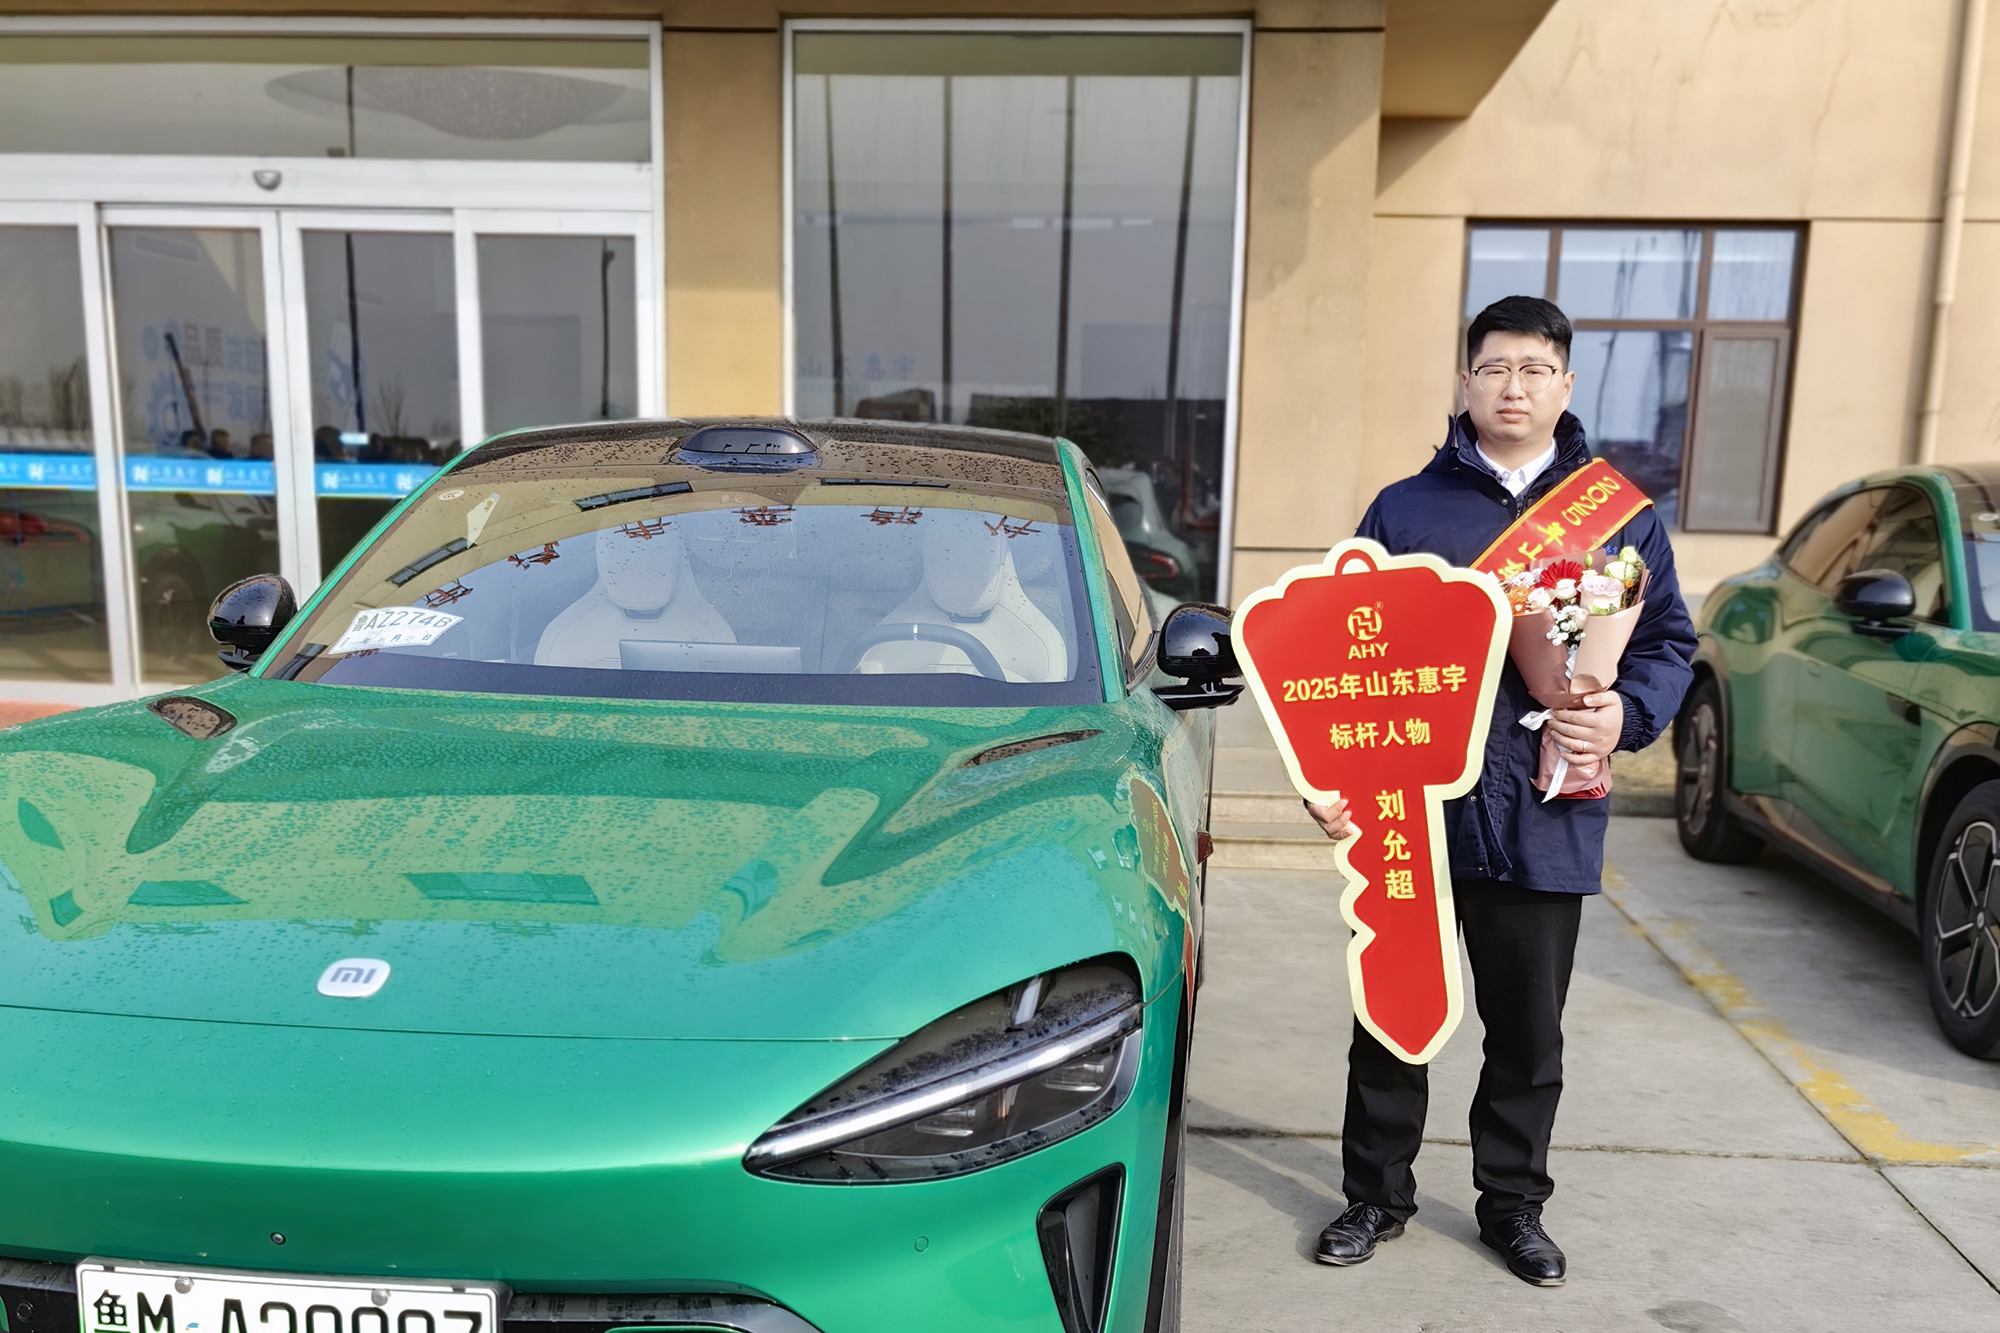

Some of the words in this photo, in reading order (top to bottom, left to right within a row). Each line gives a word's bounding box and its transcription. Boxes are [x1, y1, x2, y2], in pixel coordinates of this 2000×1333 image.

[1347, 642, 1389, 660] AHY
[1282, 664, 1467, 702] 2025年山东惠宇
[1329, 718, 1431, 750] 标杆人物
[1375, 789, 1416, 899] 刘允超
